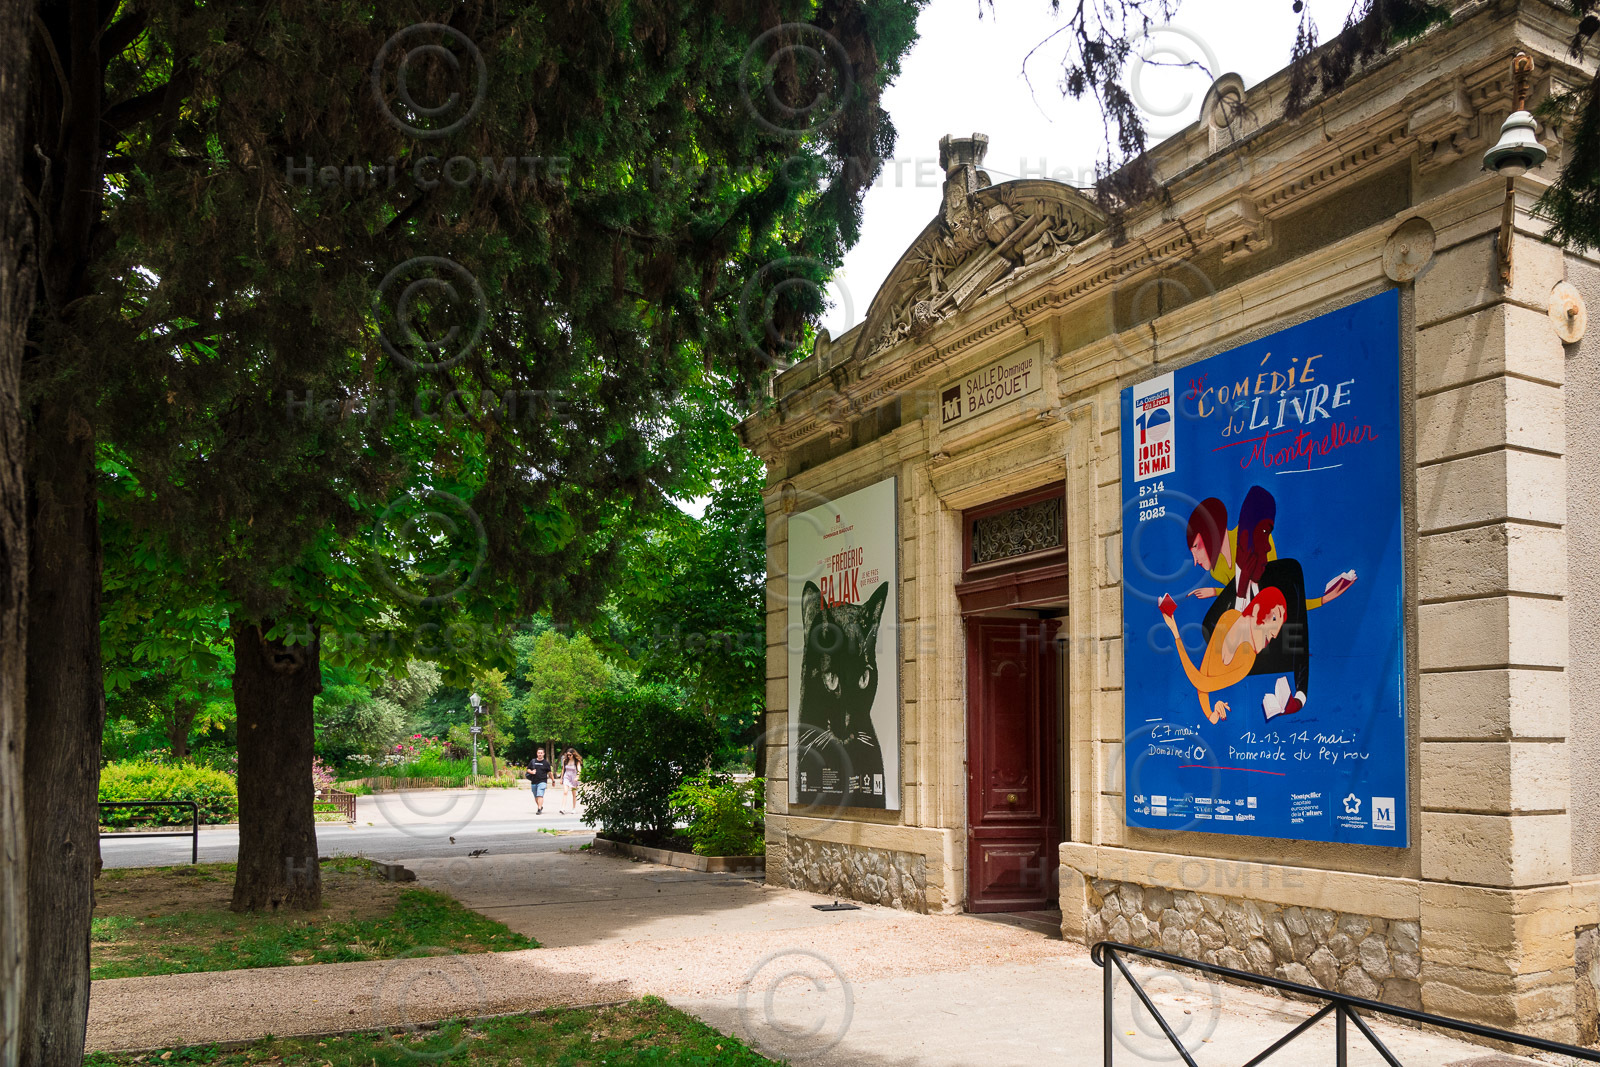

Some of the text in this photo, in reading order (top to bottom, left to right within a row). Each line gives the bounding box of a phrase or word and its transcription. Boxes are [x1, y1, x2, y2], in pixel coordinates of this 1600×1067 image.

[967, 358, 1033, 395] SALLE Dominique
[969, 371, 1030, 412] BAGOUET
[1222, 416, 1244, 437] du
[1138, 440, 1170, 462] JOURS
[1240, 416, 1379, 470] Montpellier
[1139, 455, 1170, 476] EN MAI
[1139, 494, 1158, 508] mai
[1140, 506, 1166, 522] 2023
[832, 545, 863, 573] FRÉDÉRIC
[820, 568, 860, 610] PAJAK
[1148, 744, 1182, 758] Domaine
[1230, 746, 1286, 761] Promenade
[1294, 748, 1311, 761] du
[1376, 808, 1391, 821] M
